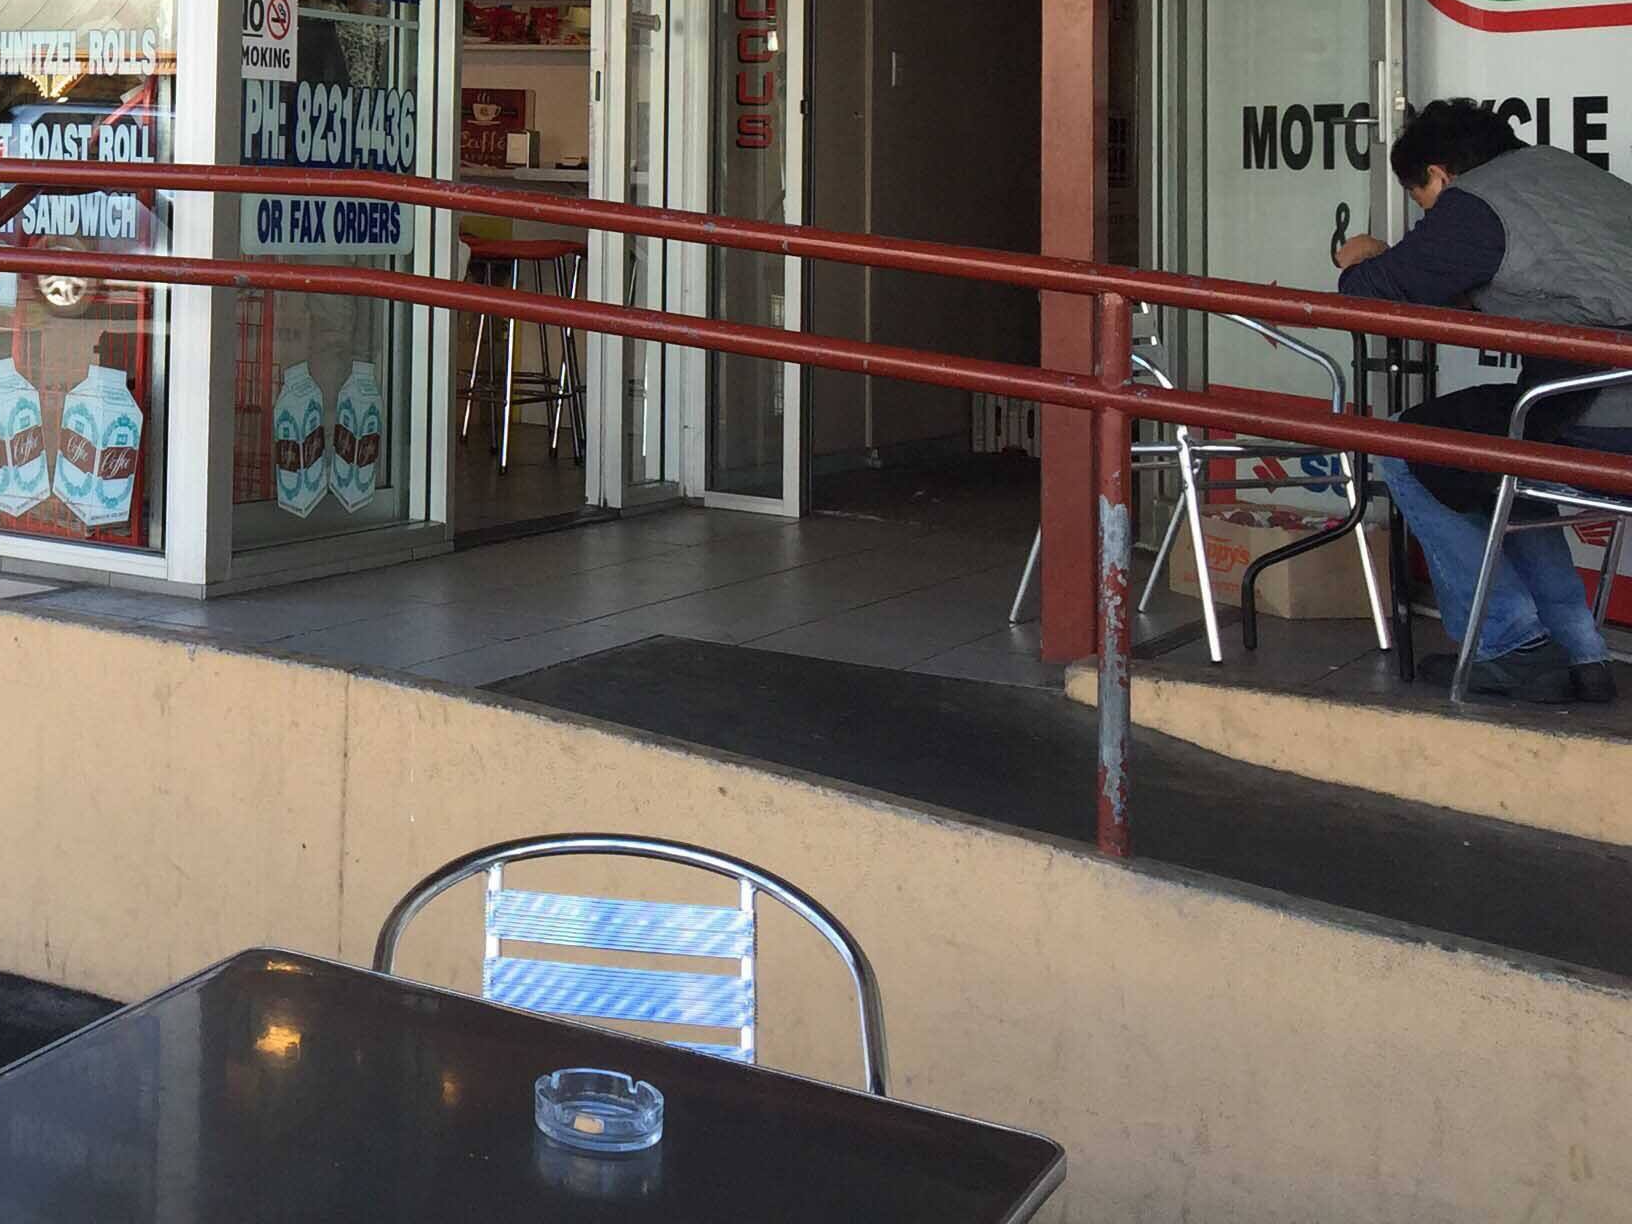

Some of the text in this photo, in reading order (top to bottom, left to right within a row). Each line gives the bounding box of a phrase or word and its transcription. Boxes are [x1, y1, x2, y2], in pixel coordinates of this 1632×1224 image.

[88, 28, 157, 76] ROLLS
[241, 46, 291, 70] MOKING
[22, 124, 93, 161] ROAST
[98, 124, 155, 163] ROLL
[295, 80, 415, 169] 82314436
[22, 190, 136, 239] SANDWICH
[257, 199, 401, 245] OR FAX ORDERS
